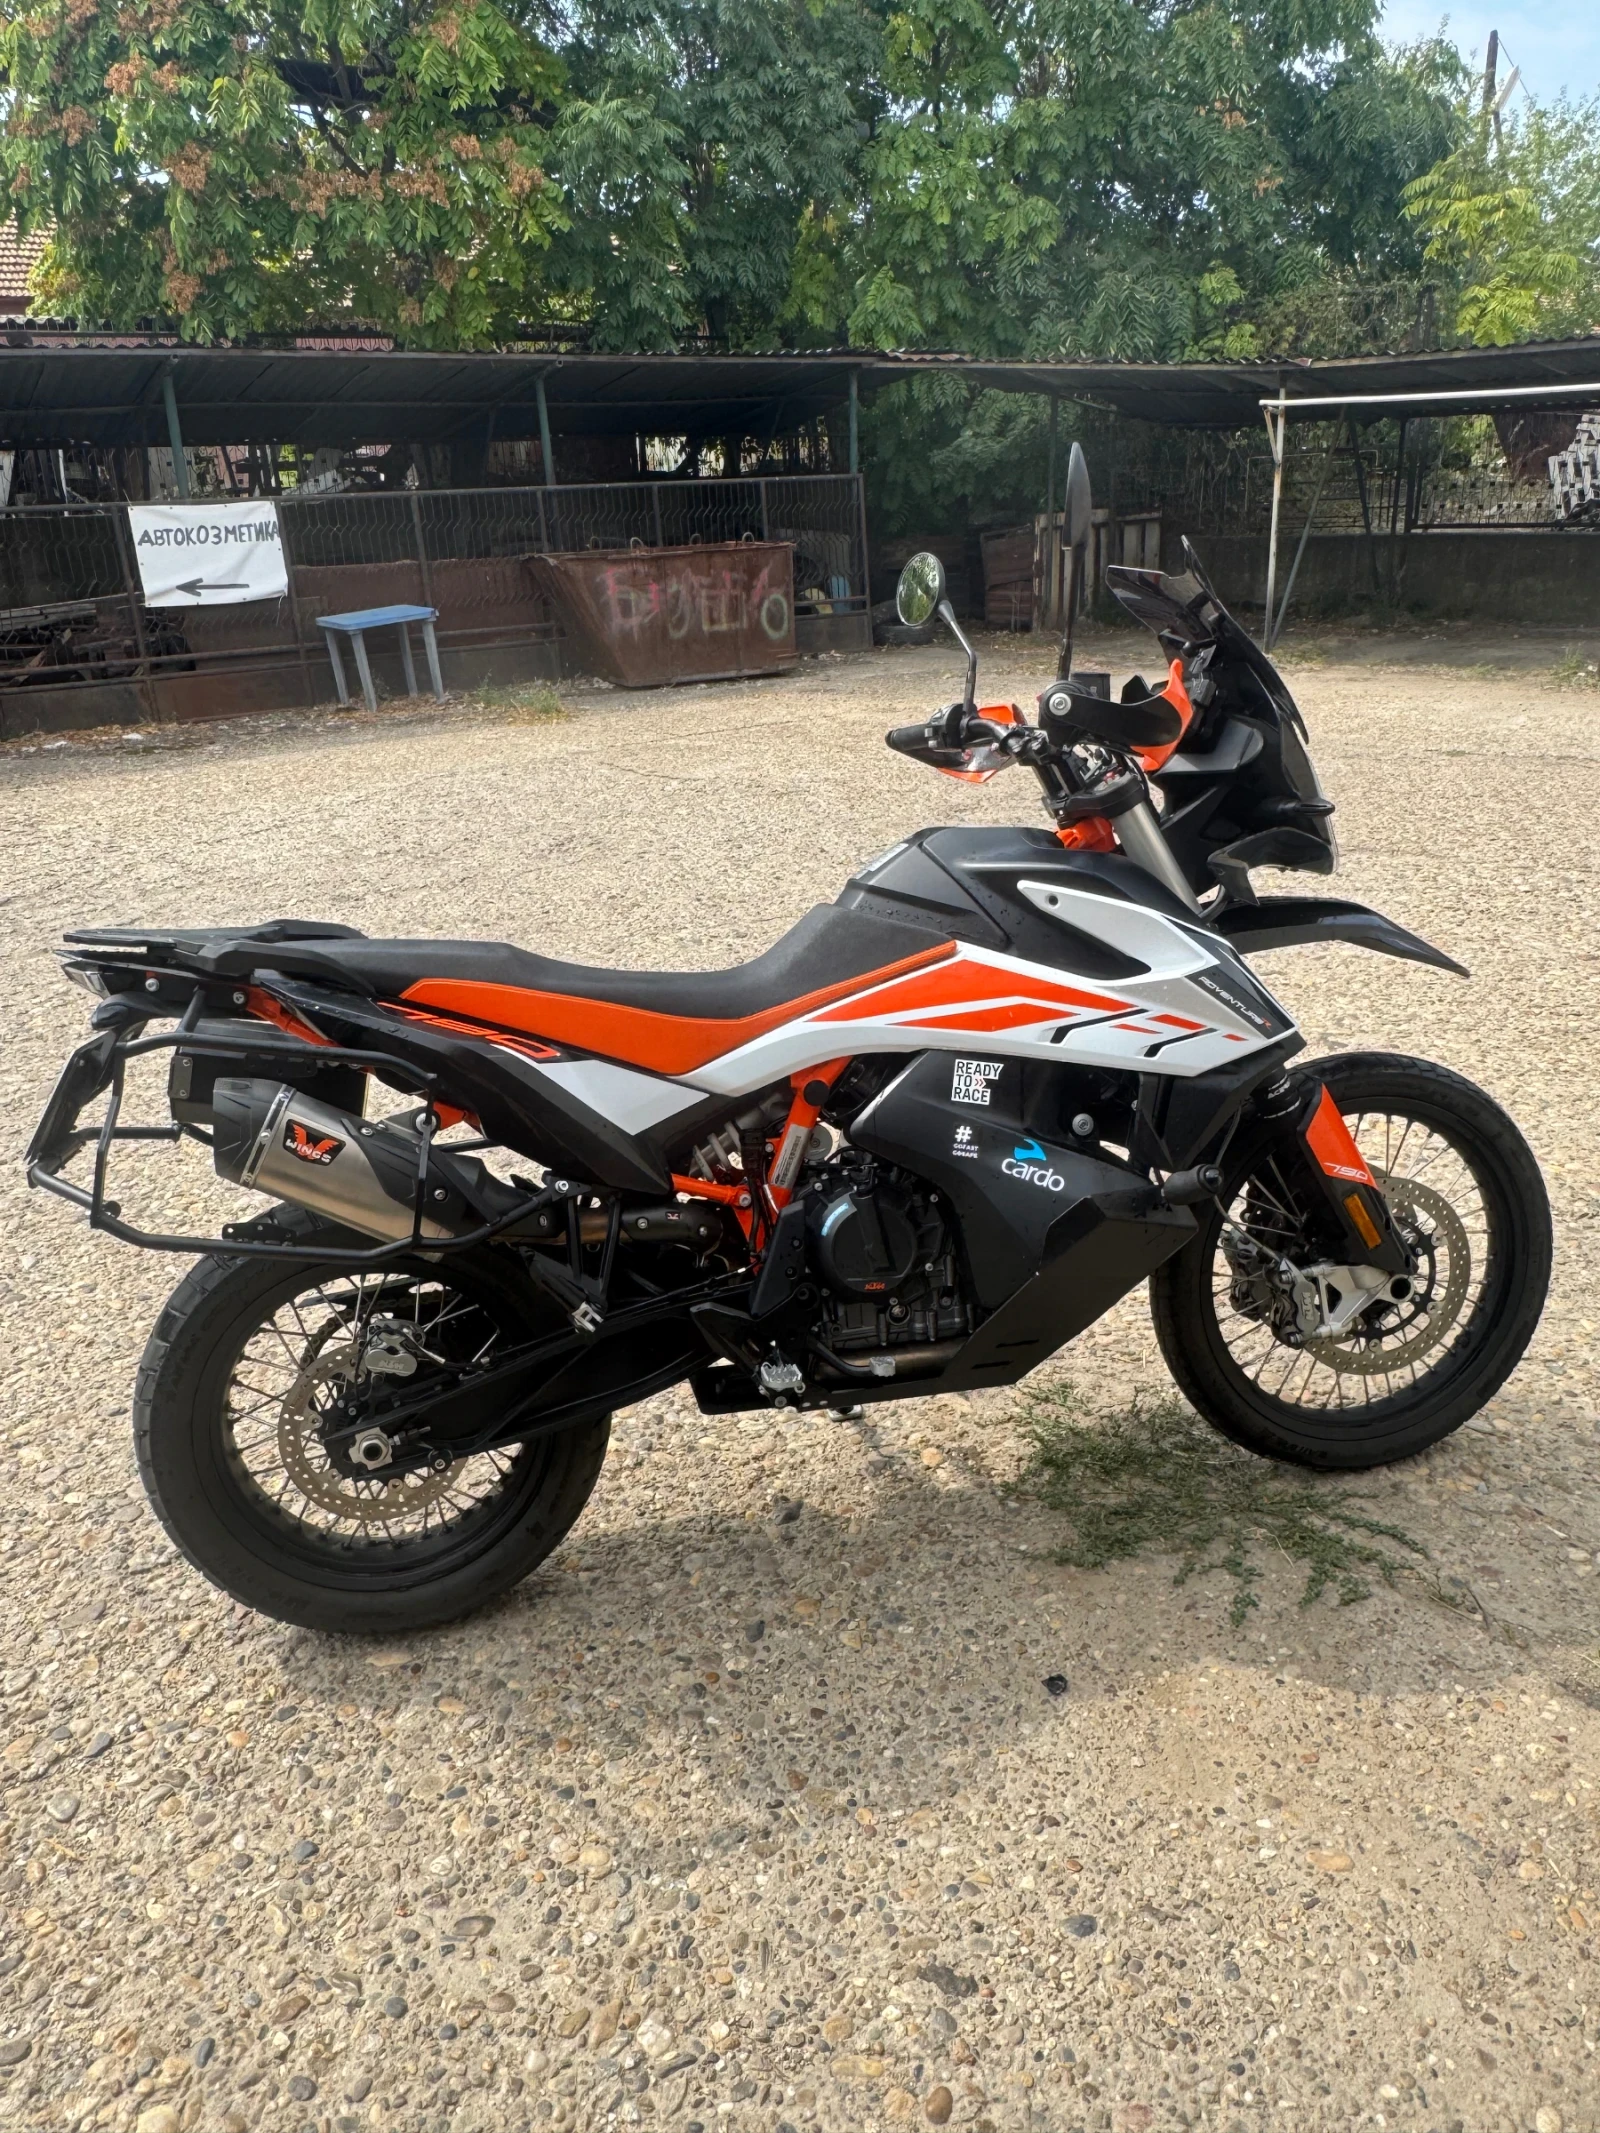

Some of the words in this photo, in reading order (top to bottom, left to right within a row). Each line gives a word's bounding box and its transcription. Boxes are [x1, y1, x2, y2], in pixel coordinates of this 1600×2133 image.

[137, 520, 281, 547] АВТОКОЗМЕТИКА
[1198, 976, 1265, 1025] ADVENTURE
[377, 1001, 561, 1059] 790
[956, 1061, 1001, 1078] READY
[956, 1074, 973, 1088] TO
[953, 1086, 989, 1103] RACE
[285, 1138, 332, 1164] WINGS
[1001, 1158, 1066, 1192] cardo
[1323, 1162, 1369, 1180] 790
